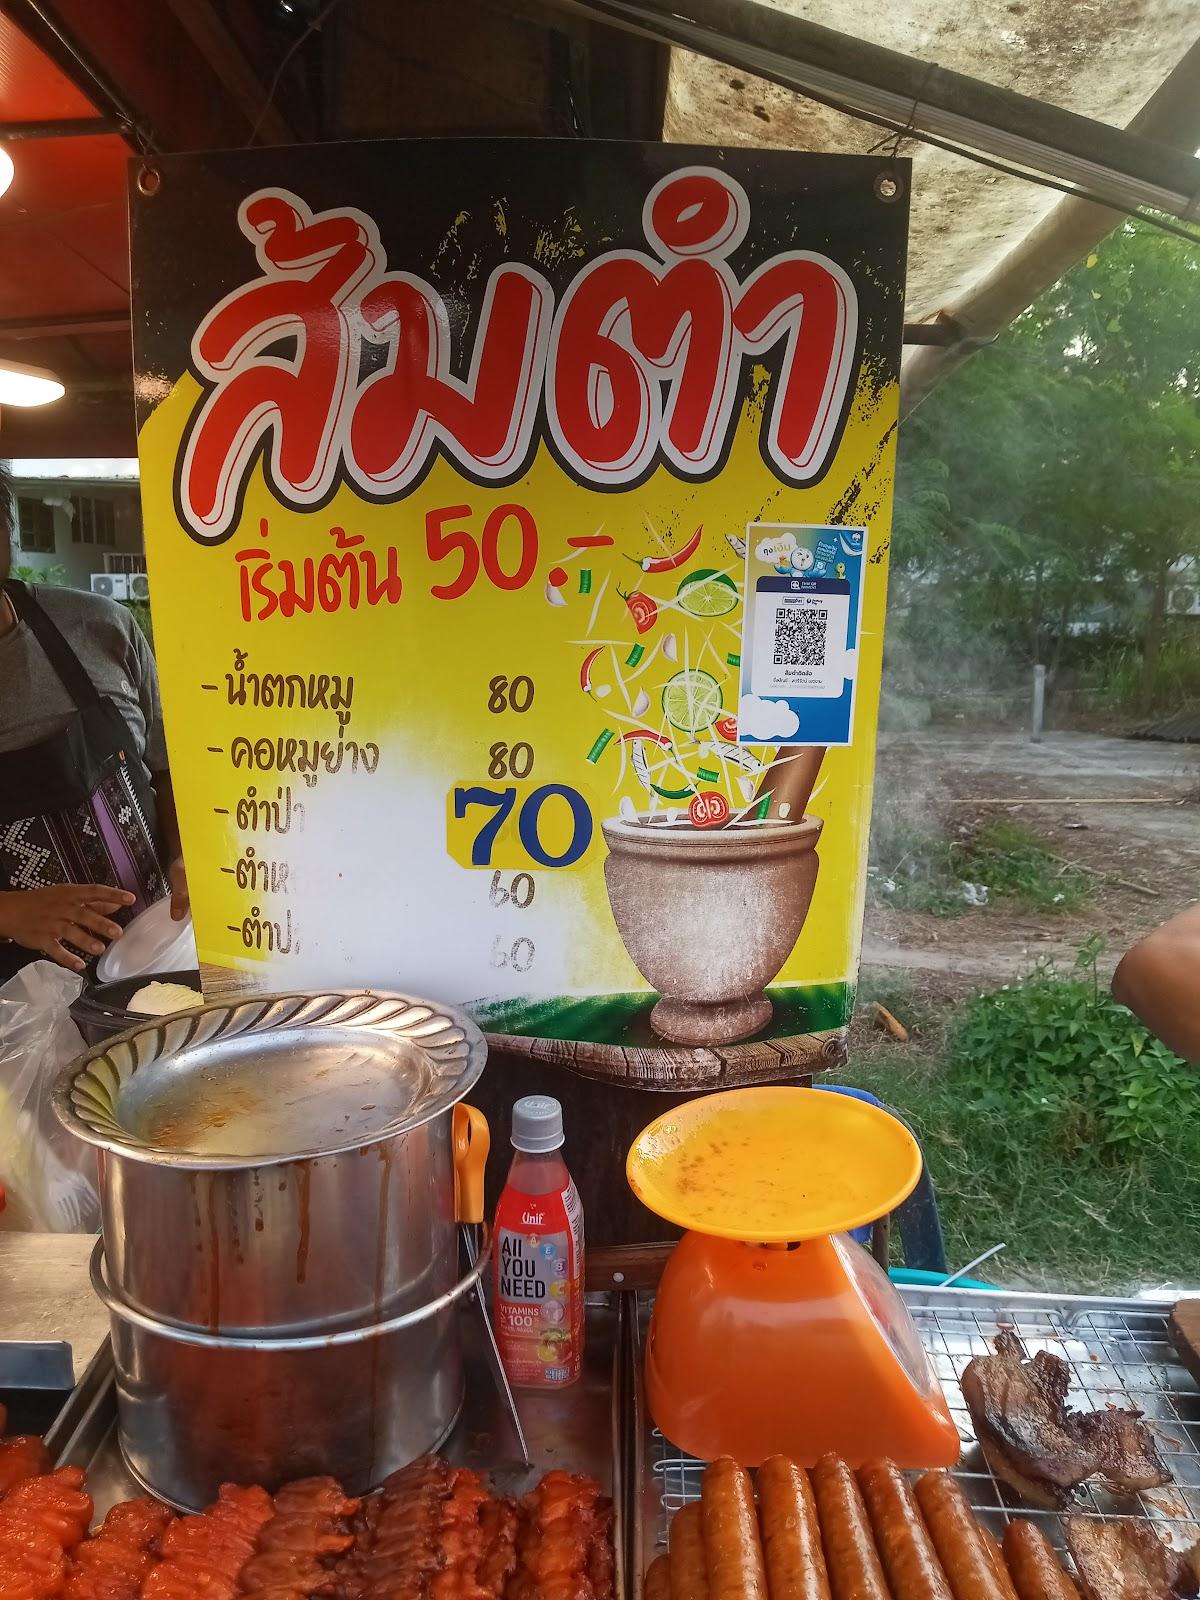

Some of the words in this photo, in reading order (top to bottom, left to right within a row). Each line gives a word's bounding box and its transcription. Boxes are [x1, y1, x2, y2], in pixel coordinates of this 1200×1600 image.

[180, 166, 858, 539] ส้มตำ
[234, 517, 403, 623] เริ่มต้น
[487, 675, 535, 714] 80
[488, 741, 535, 780] 80
[454, 783, 593, 868] 70
[489, 871, 536, 910] 60
[490, 934, 537, 973] 60
[521, 1211, 545, 1225] Unif
[502, 1236, 522, 1258] All
[502, 1255, 536, 1279] YOU
[501, 1277, 546, 1299] NEED
[500, 1304, 539, 1316] VITAMINS
